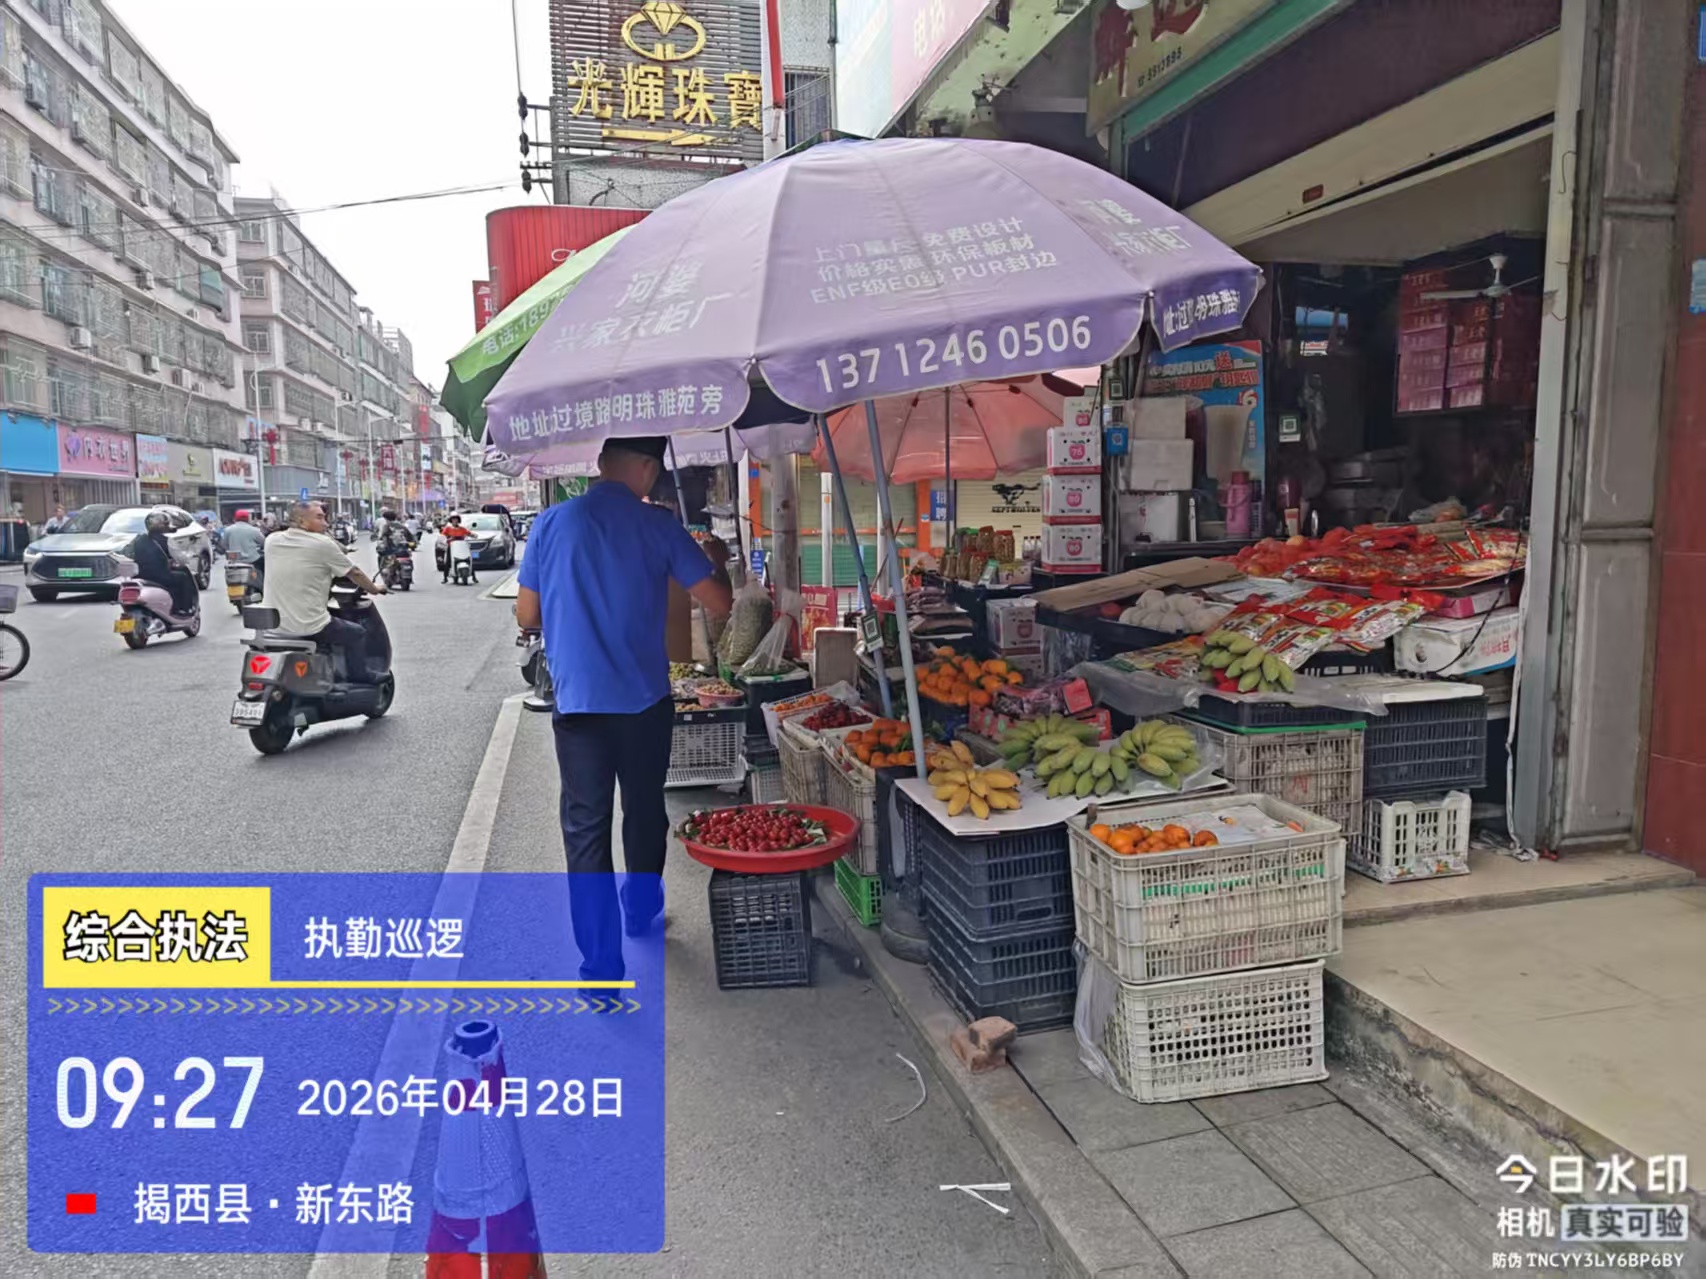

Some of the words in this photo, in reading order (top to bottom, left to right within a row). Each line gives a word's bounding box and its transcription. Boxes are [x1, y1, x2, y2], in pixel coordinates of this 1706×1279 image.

[568, 56, 762, 131] 光輝珠寶
[818, 254, 925, 283] 价格实惠
[930, 233, 1036, 267] 环保板材
[922, 216, 1023, 248] 免费设计
[952, 250, 1058, 281] PUR封边
[816, 348, 881, 393] 137
[895, 329, 988, 377] 1246
[998, 315, 1091, 360] 0506
[509, 383, 724, 442] 地址过境路明珠雅苑旁
